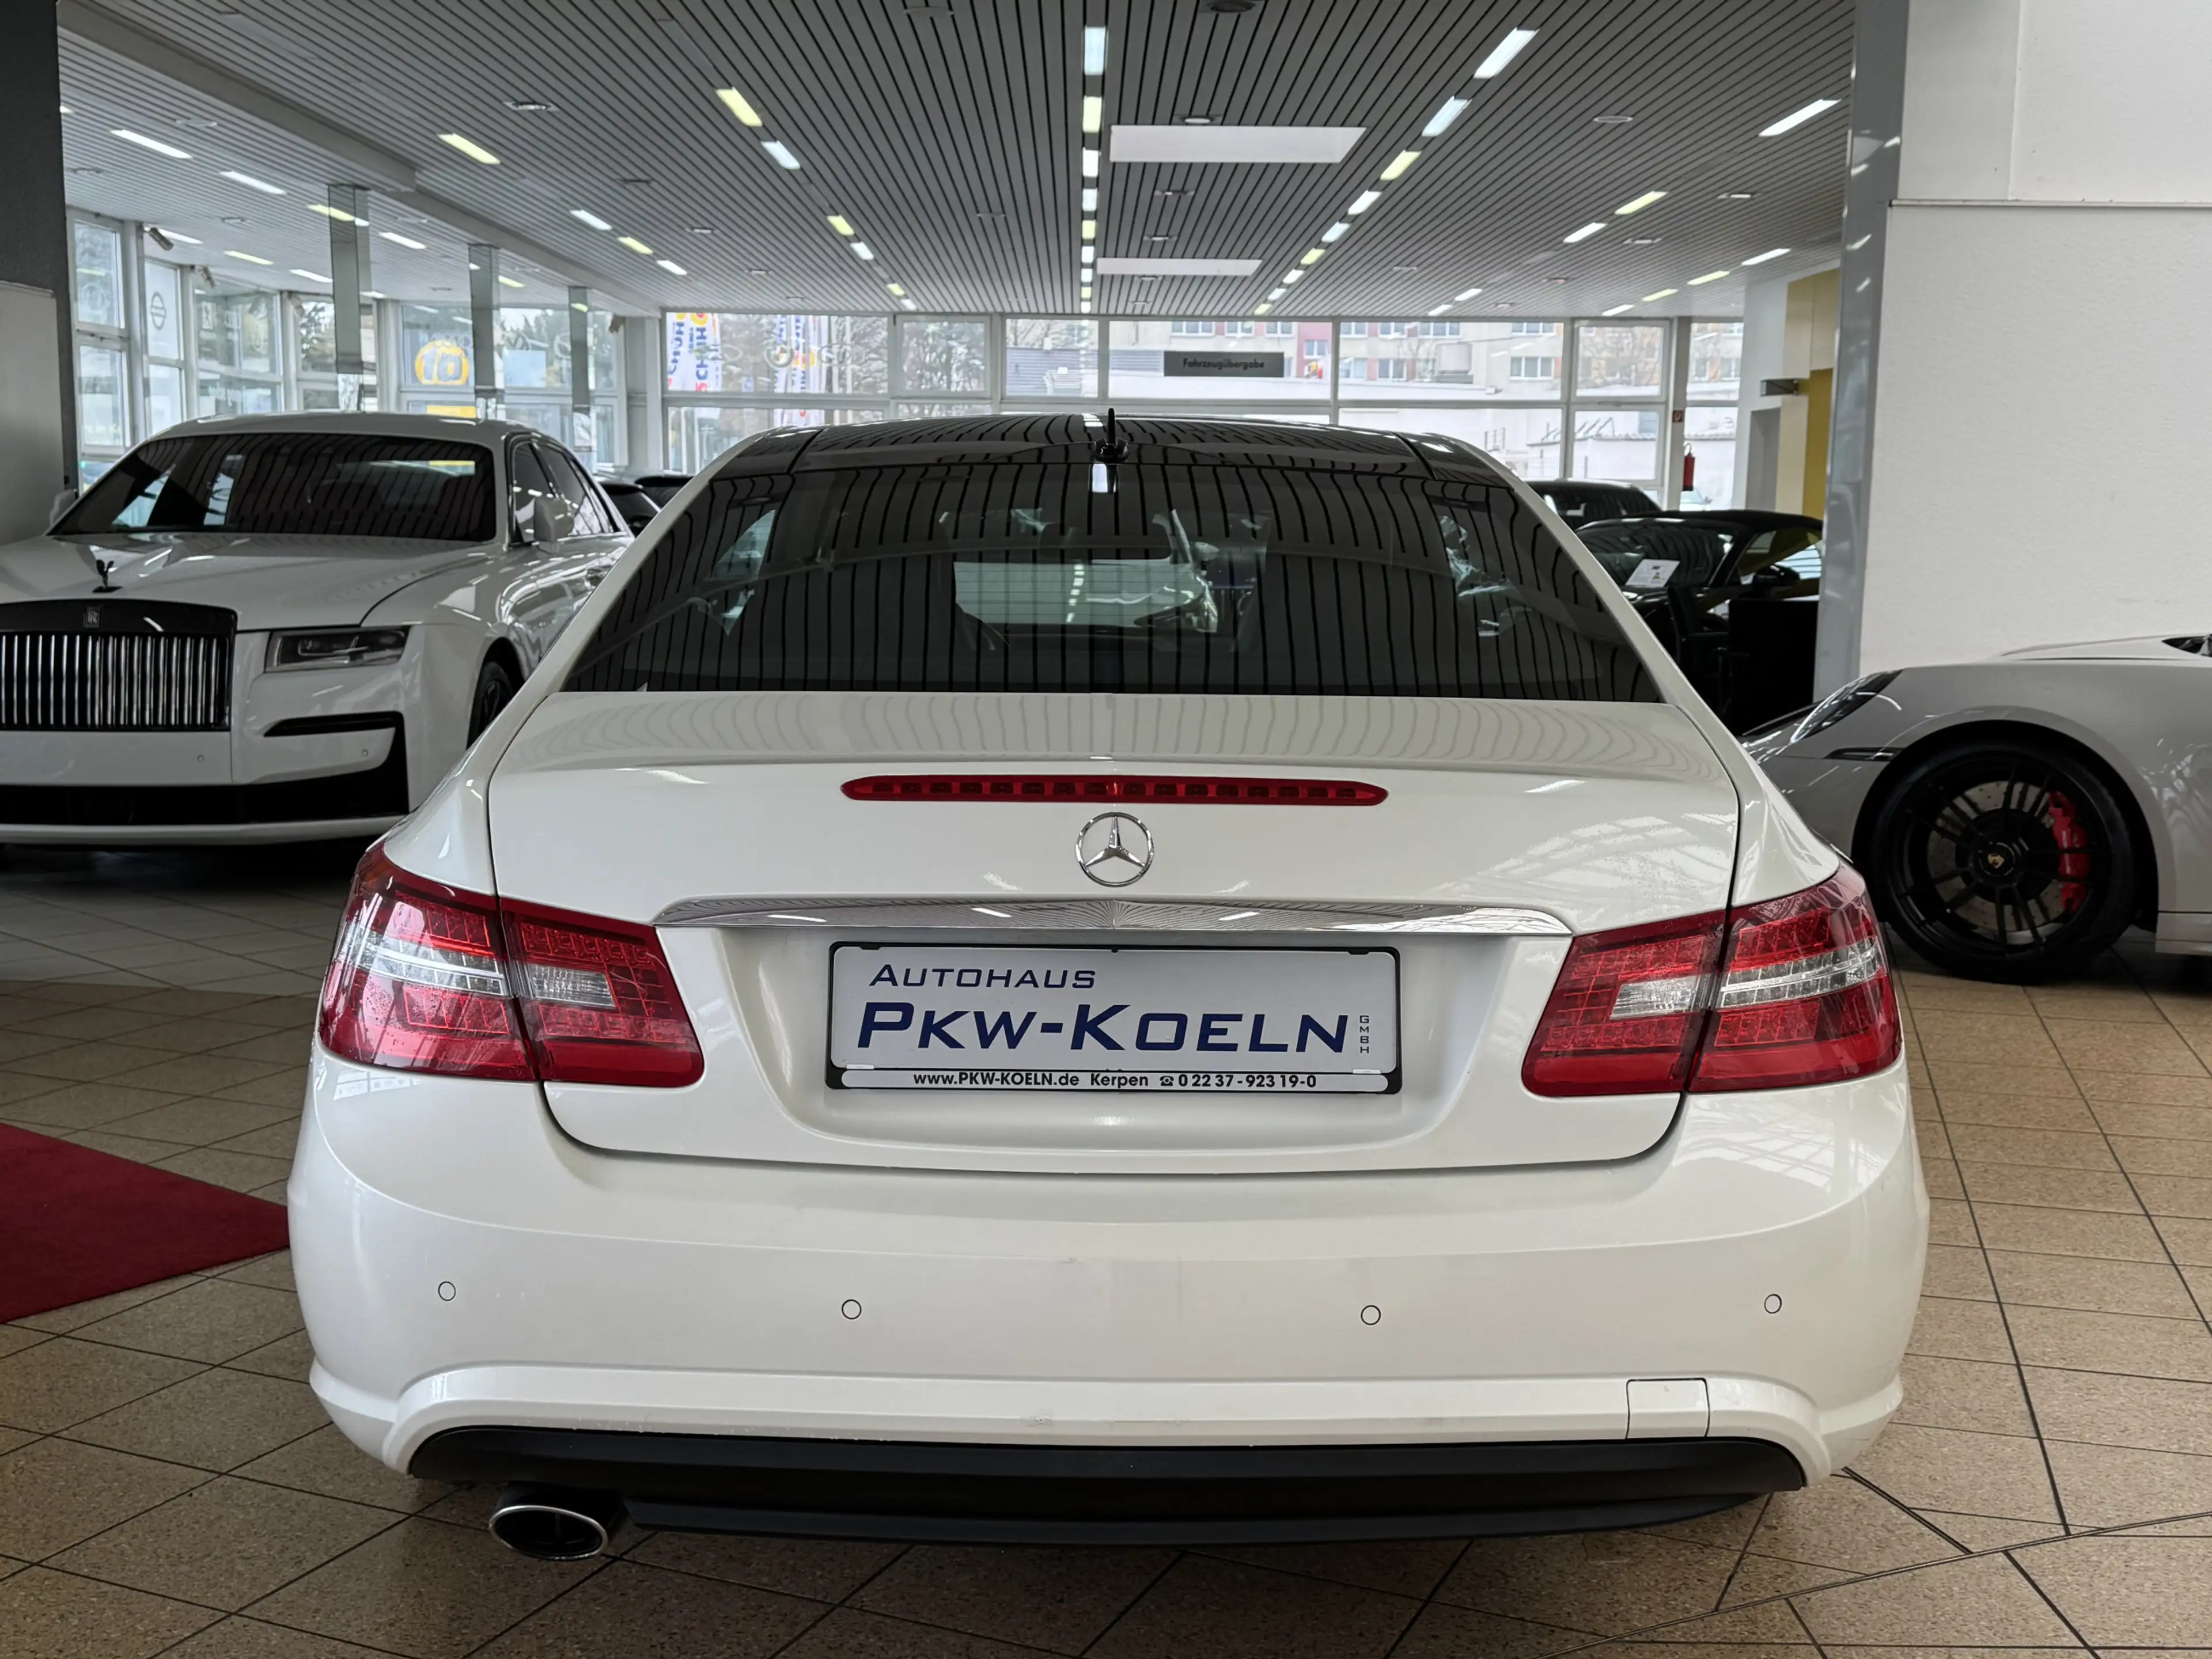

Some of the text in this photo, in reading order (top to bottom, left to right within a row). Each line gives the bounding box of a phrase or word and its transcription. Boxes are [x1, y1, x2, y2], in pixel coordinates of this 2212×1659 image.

[869, 964, 1096, 988] AUTOHAUS
[857, 1002, 1349, 1054] PKW-KOELN
[913, 1072, 1080, 1086] www.PKW-KOELN.de
[1090, 1073, 1149, 1089] Kerpen
